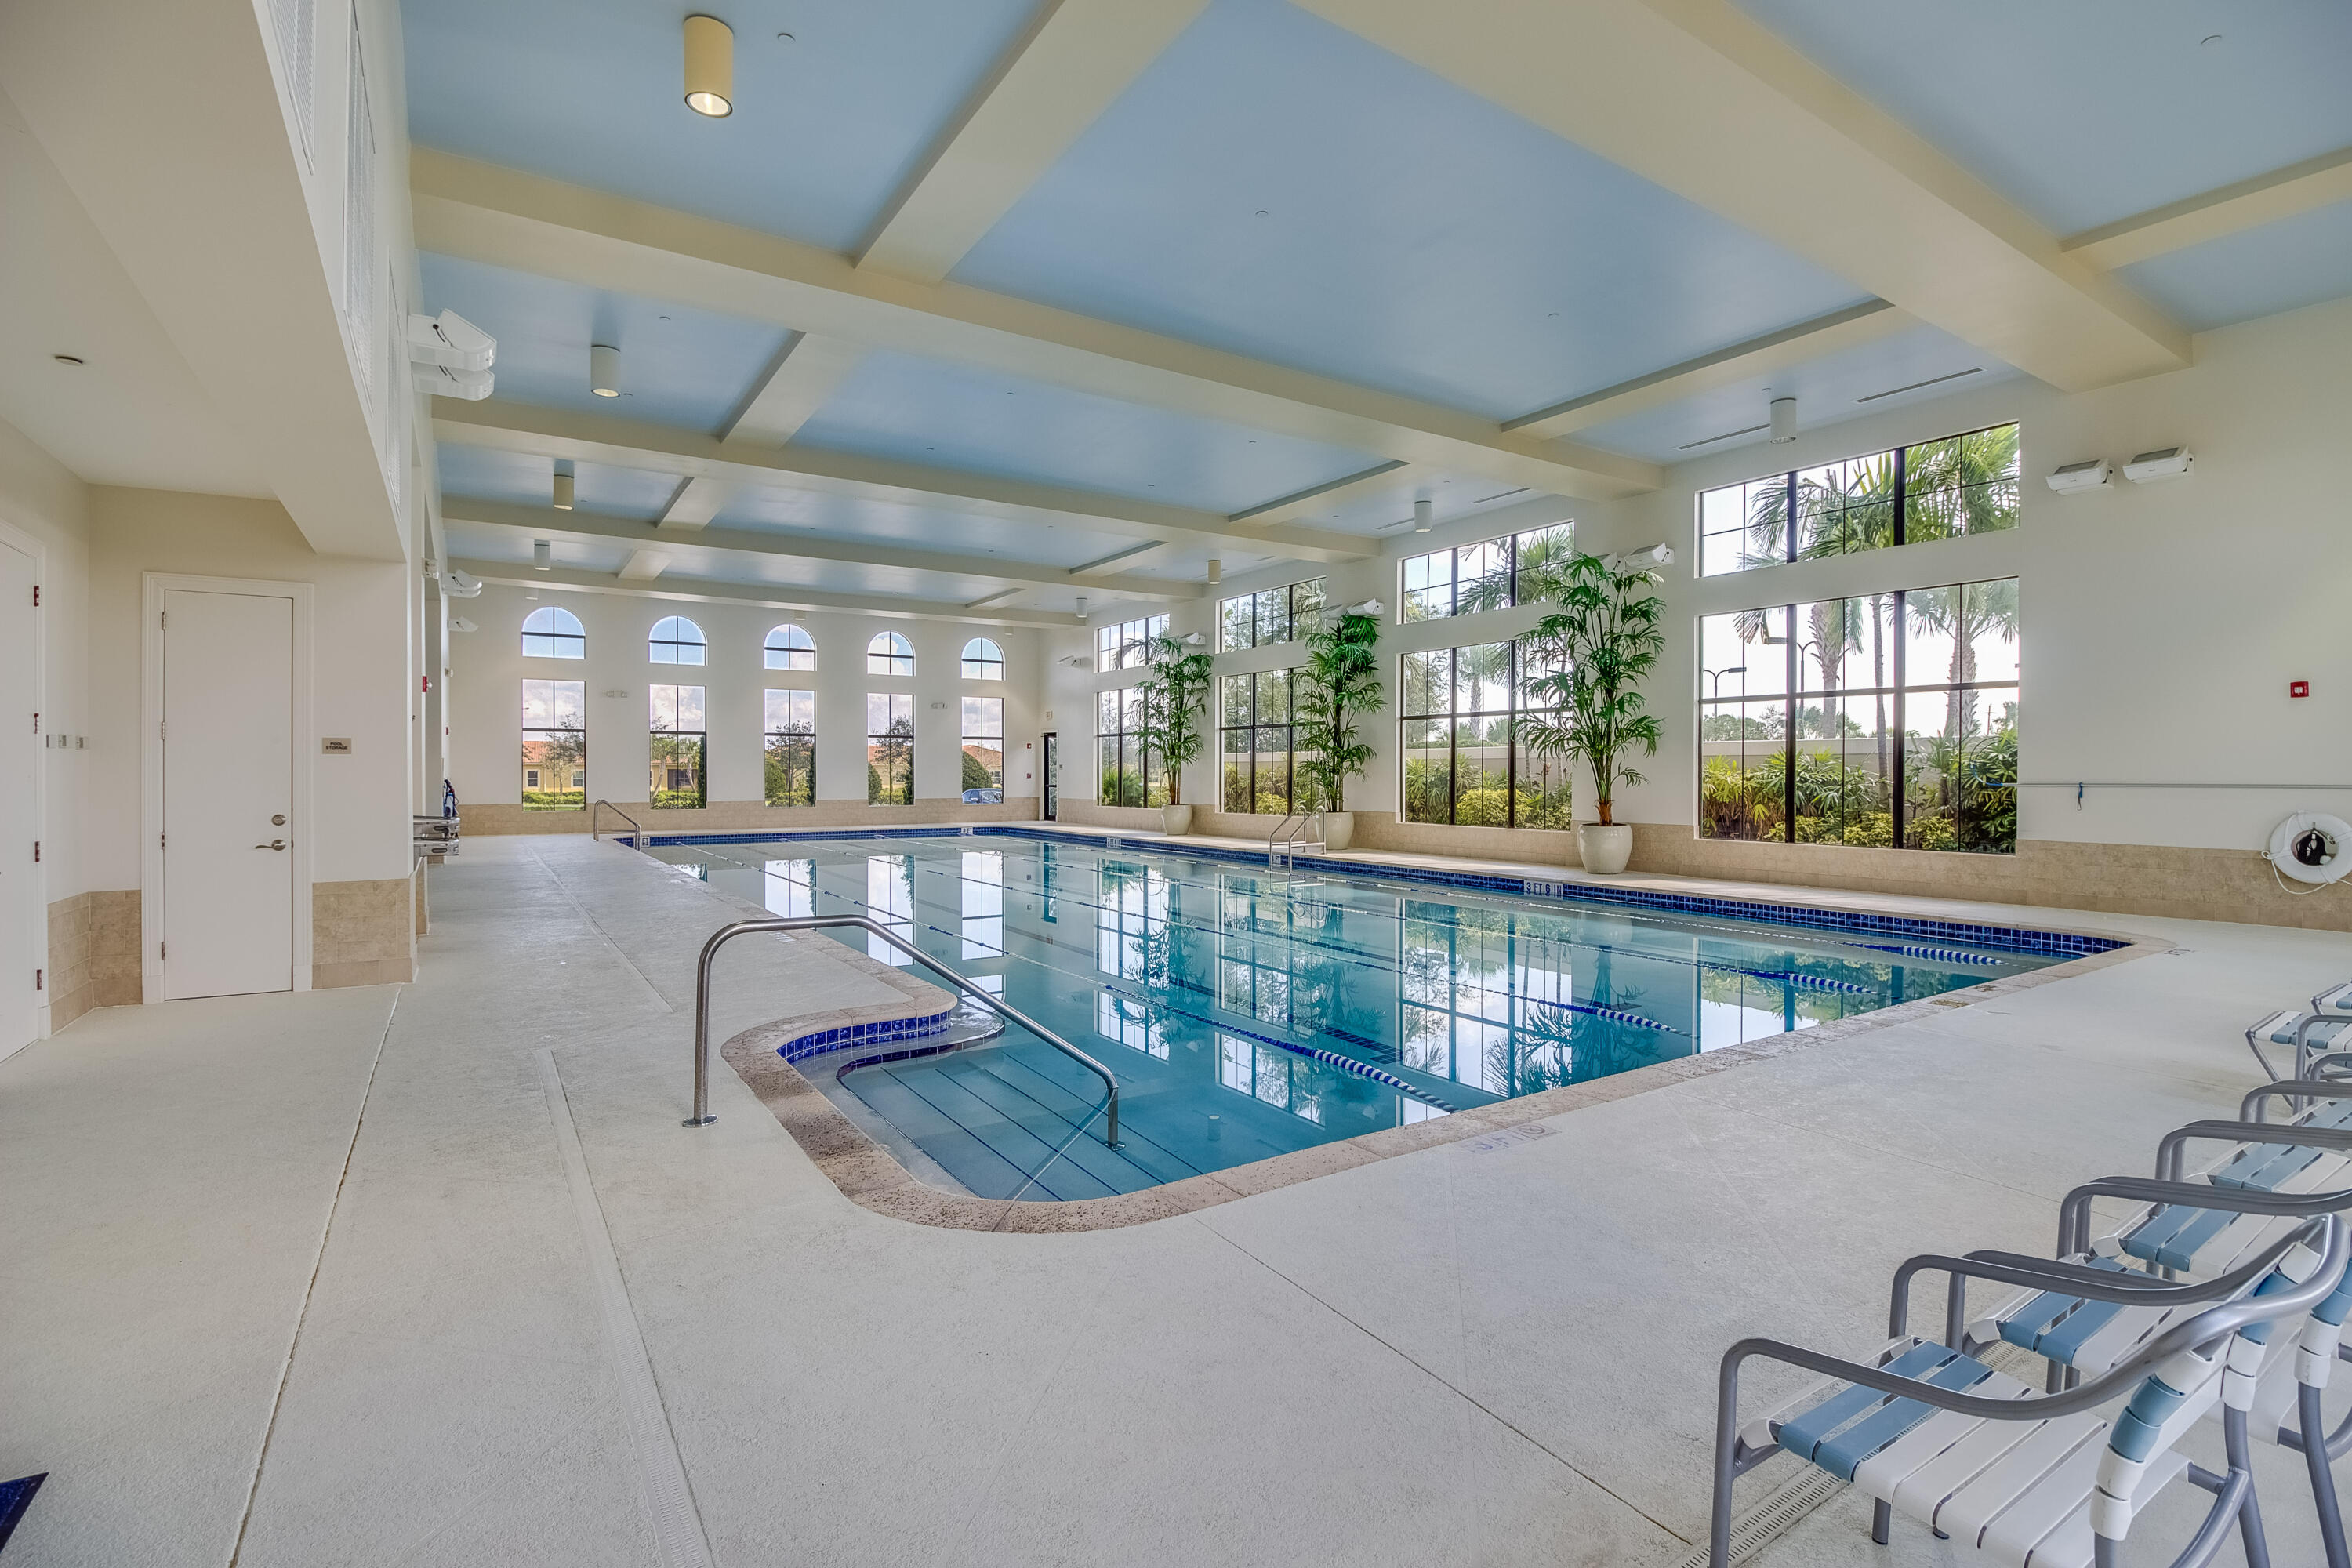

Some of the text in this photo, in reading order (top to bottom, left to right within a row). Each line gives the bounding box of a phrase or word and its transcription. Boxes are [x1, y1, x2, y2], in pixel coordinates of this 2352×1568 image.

[1526, 882, 1562, 895] 3 FT 6 IN
